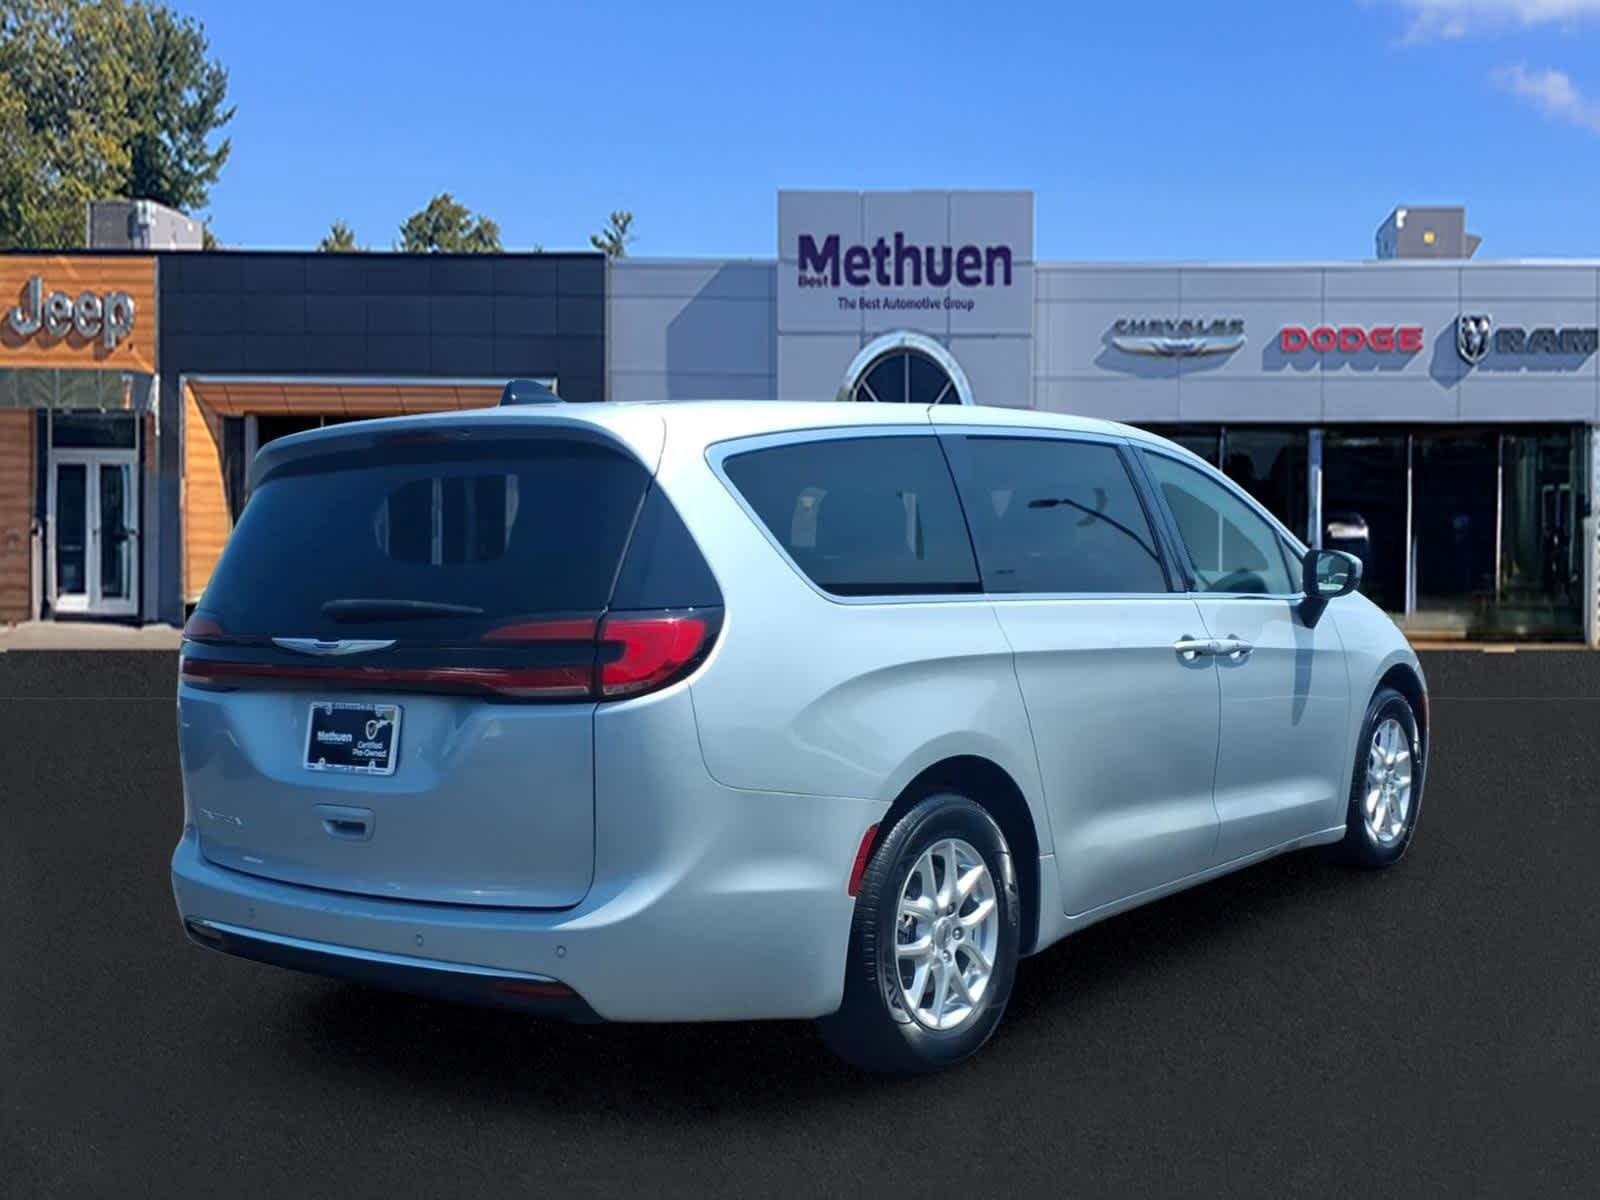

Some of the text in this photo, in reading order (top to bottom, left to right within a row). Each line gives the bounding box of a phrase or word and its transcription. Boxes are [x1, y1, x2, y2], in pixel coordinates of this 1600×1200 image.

[798, 231, 1012, 287] Methuen
[9, 275, 135, 349] Jeep
[838, 297, 975, 313] The Best Automotive Group
[1114, 319, 1245, 334] CHRYSLER
[1281, 327, 1424, 352] DODGE
[1495, 328, 1599, 352] RAM
[317, 730, 352, 742] Methuen
